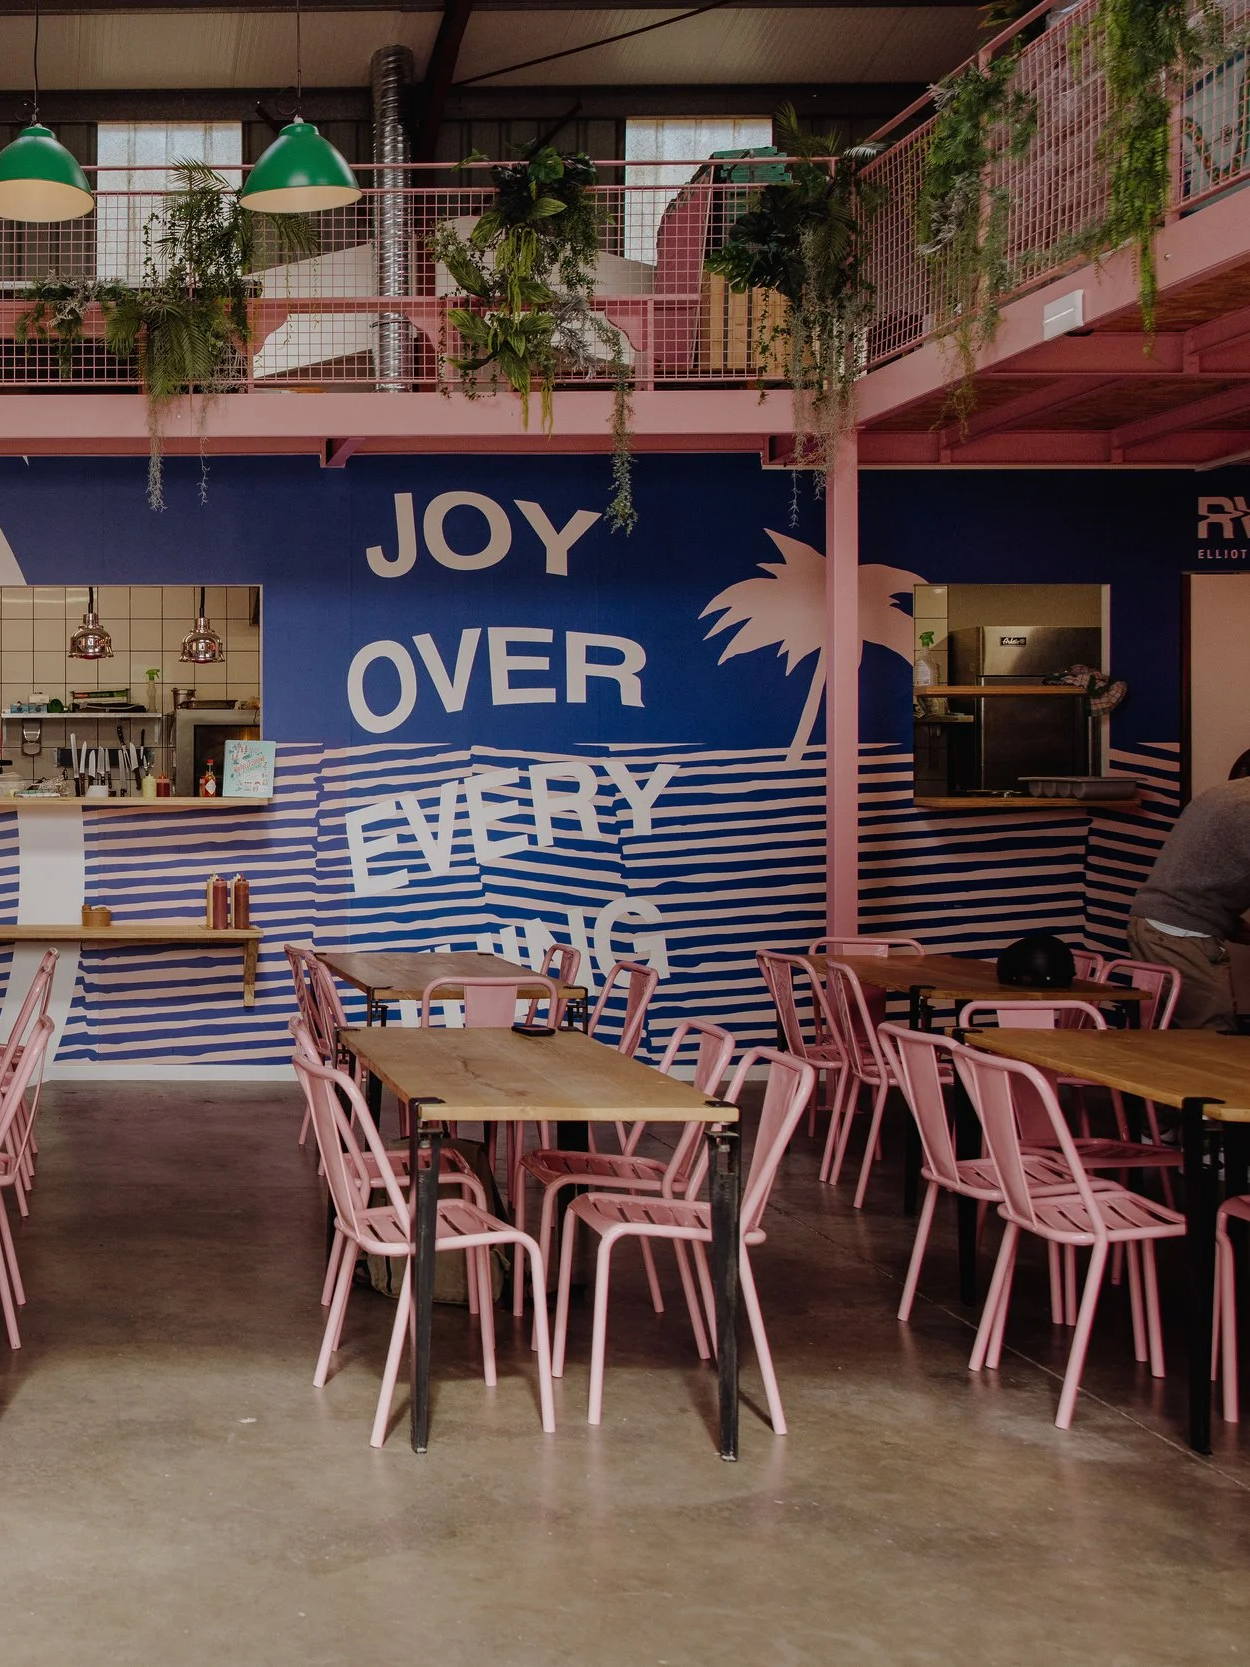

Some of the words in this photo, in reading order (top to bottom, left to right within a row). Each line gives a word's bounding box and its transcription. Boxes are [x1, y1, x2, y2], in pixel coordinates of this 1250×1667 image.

[366, 490, 602, 578] JOY
[1197, 549, 1248, 559] ELLIOT
[347, 626, 647, 734] OVER
[345, 761, 680, 898] EVERY
